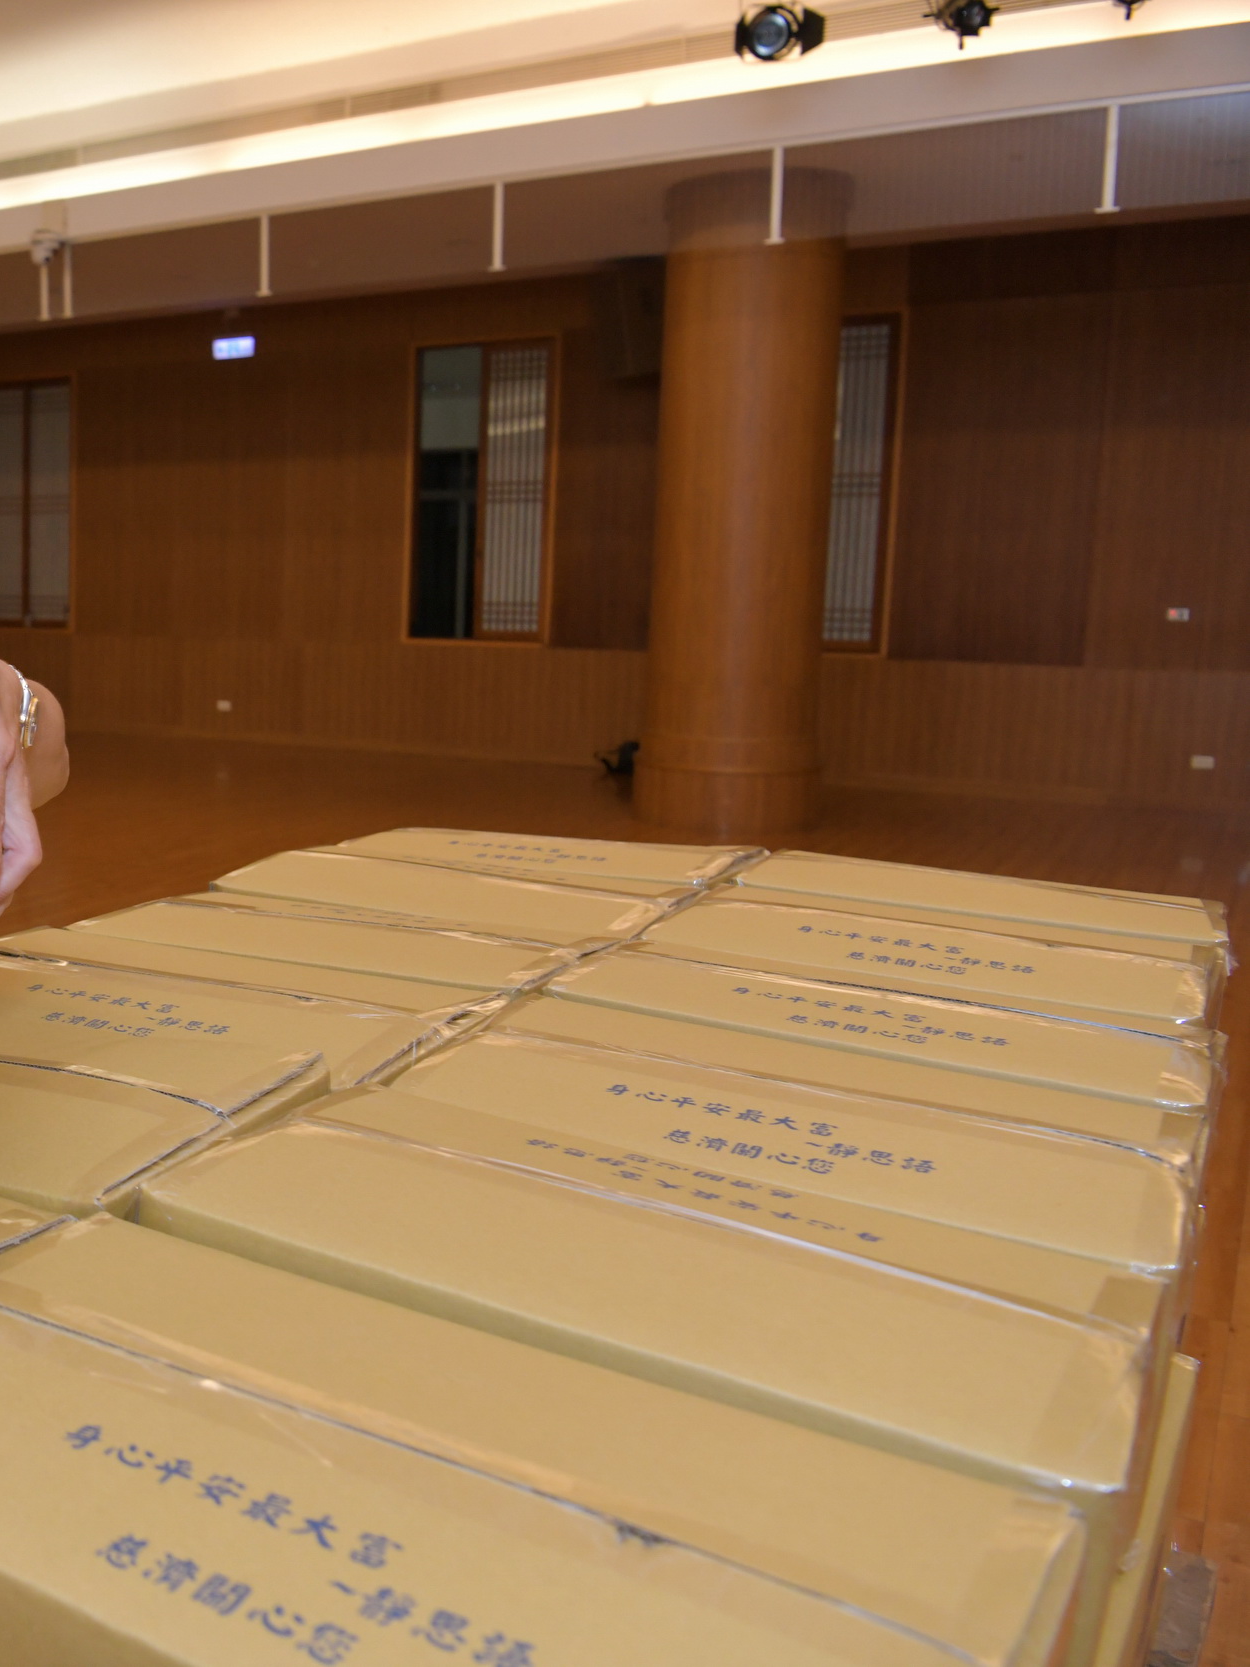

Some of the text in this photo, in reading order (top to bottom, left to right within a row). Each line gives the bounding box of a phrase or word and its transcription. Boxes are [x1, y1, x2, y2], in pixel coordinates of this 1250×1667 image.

[731, 986, 927, 1023] 身心平安最大富
[606, 1084, 838, 1137] 身心平安最大富
[663, 1129, 836, 1175] 慈濟關心您
[63, 1424, 405, 1569] 身心平安最大富
[95, 1534, 360, 1666] 慈濟關心您
